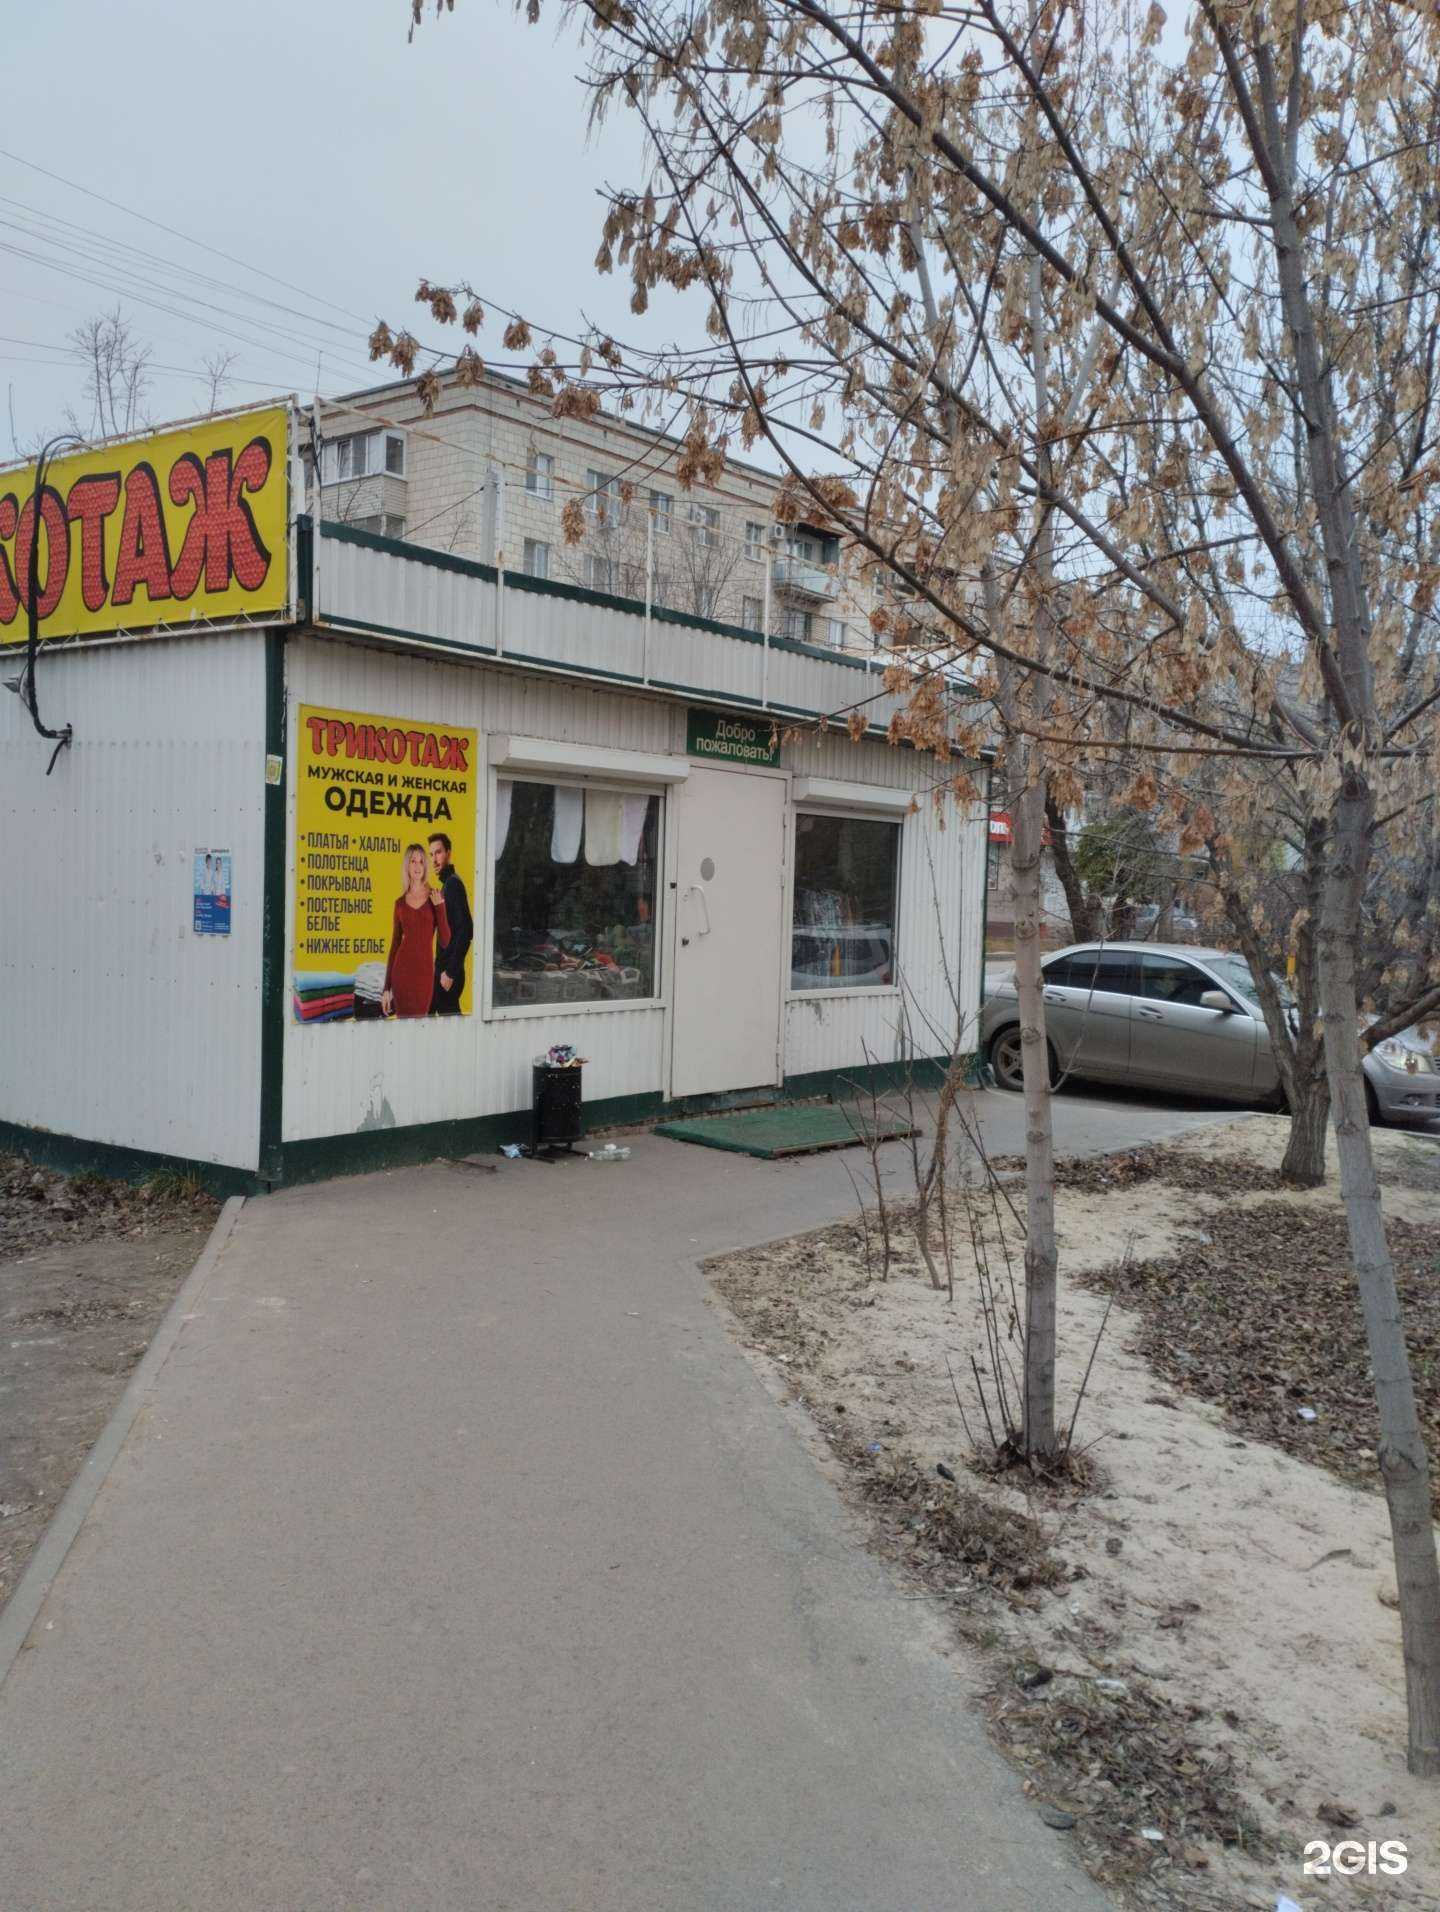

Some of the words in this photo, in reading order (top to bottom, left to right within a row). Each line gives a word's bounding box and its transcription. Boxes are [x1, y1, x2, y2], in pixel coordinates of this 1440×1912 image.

[715, 719, 756, 743] Добро
[306, 716, 470, 772] ТРИКОТАЖ
[308, 765, 383, 786] МУЖСКАЯ
[388, 774, 398, 787] И
[401, 776, 467, 794] ЖЕНСКАЯ
[324, 786, 452, 823] ОДЕЖДА
[307, 832, 349, 849] ПЛАТЬЯ
[359, 835, 401, 853] ХАЛАТЫ
[307, 853, 369, 873] ПОЛОТЕНЦА
[307, 875, 372, 893] ПОКРЫВАЛА
[306, 897, 373, 914] ПОСТЕЛЬНОЕ
[306, 915, 341, 932] БЕЛЬЕ
[306, 939, 351, 954] НИЖНЕЕ
[353, 938, 385, 954] БЕЛЬЕ
